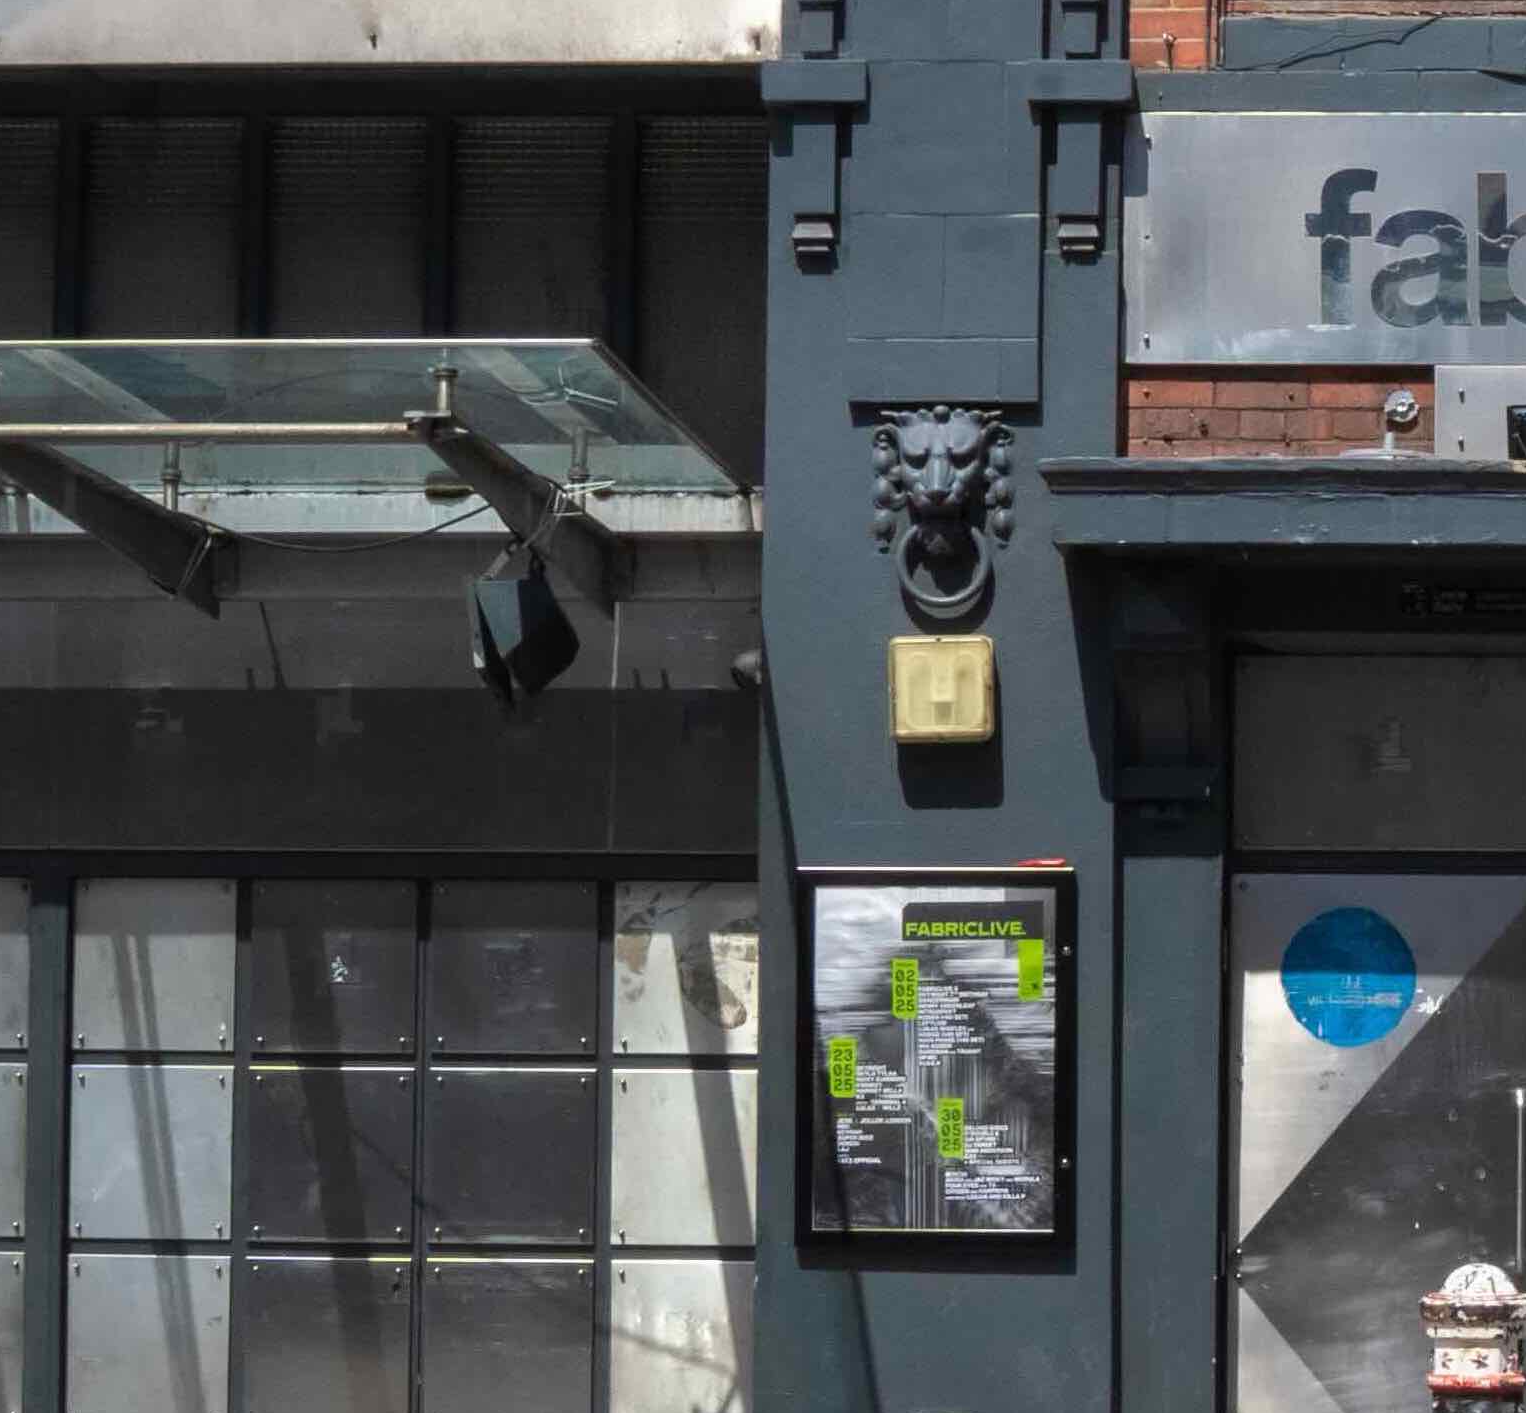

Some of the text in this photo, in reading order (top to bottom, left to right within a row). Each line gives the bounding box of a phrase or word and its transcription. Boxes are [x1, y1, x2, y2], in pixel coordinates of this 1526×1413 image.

[895, 970, 915, 981] 02
[895, 985, 915, 996] 05
[895, 999, 915, 1012] 25
[833, 1049, 853, 1061] 23
[833, 1063, 853, 1076] 05
[833, 1079, 853, 1091] 25
[942, 1109, 961, 1121] 30
[942, 1124, 961, 1136] 05
[942, 1139, 961, 1151] 25
